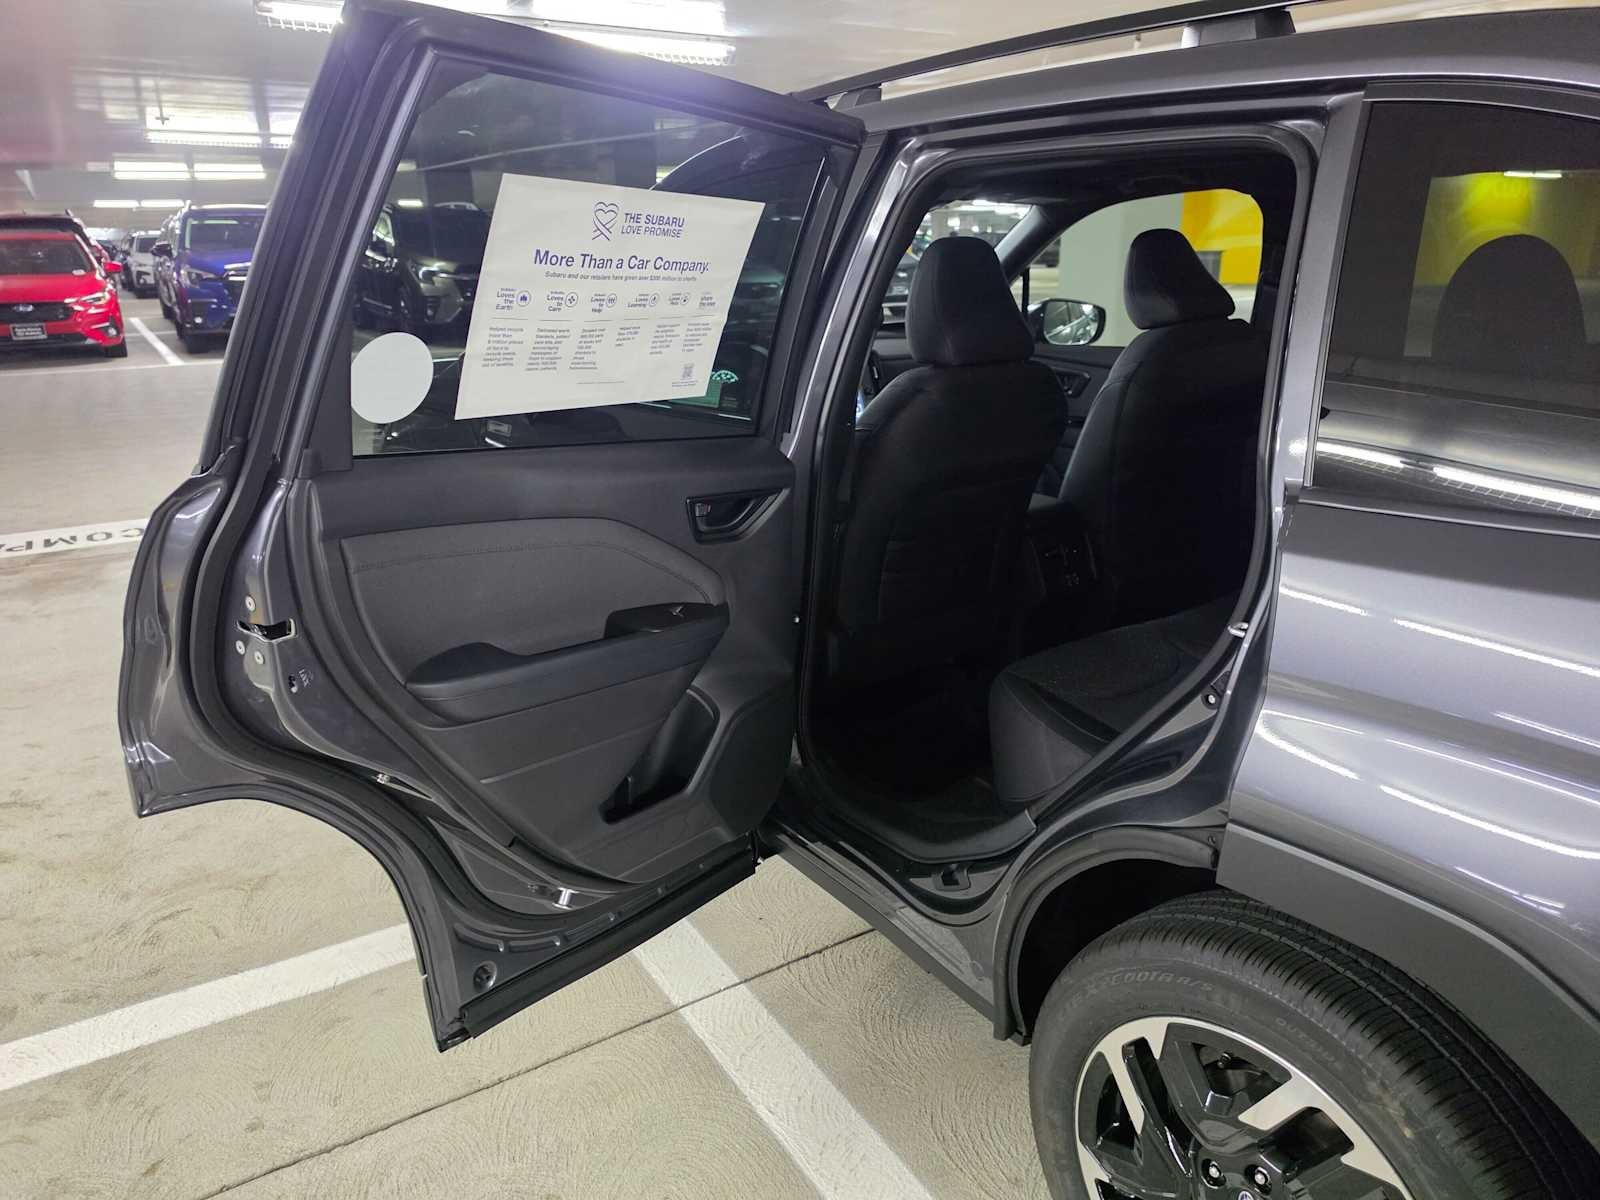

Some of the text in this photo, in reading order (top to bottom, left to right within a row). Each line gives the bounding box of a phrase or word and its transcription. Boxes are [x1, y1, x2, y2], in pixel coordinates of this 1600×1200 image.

[624, 212, 685, 228] THE SUBARU
[621, 225, 683, 238] LOVE PROMISE
[534, 249, 575, 267] More
[580, 253, 613, 269] Than
[615, 258, 624, 269] a
[628, 255, 651, 270] Car
[545, 270, 567, 279] Subaru
[496, 290, 515, 299] Loves
[495, 303, 513, 311] Earth
[0, 527, 144, 552] COMP
